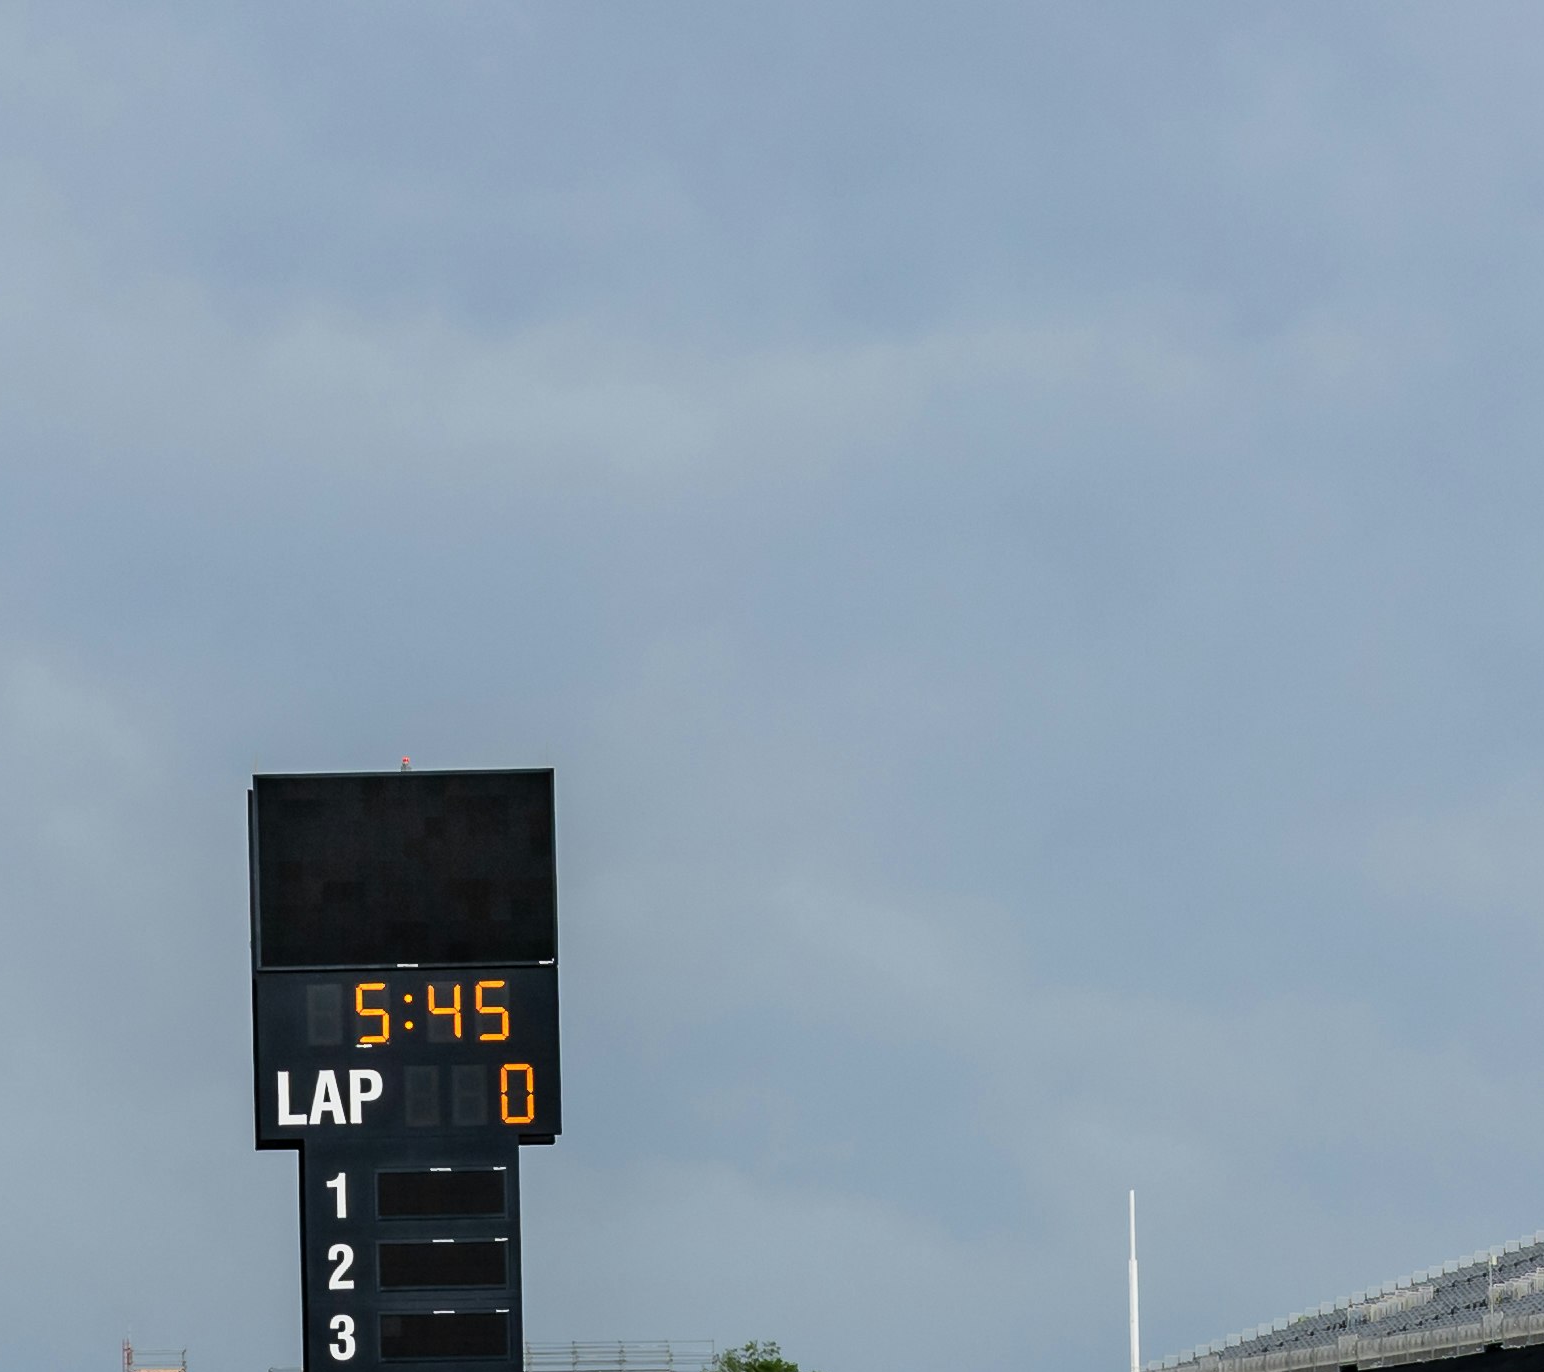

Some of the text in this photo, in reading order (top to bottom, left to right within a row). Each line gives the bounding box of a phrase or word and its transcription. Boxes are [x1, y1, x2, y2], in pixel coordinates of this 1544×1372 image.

[355, 980, 510, 1044] 5:45
[277, 1063, 535, 1126] LAP 0
[327, 1173, 348, 1219] 1
[327, 1243, 355, 1291] 2
[329, 1314, 356, 1361] 3
